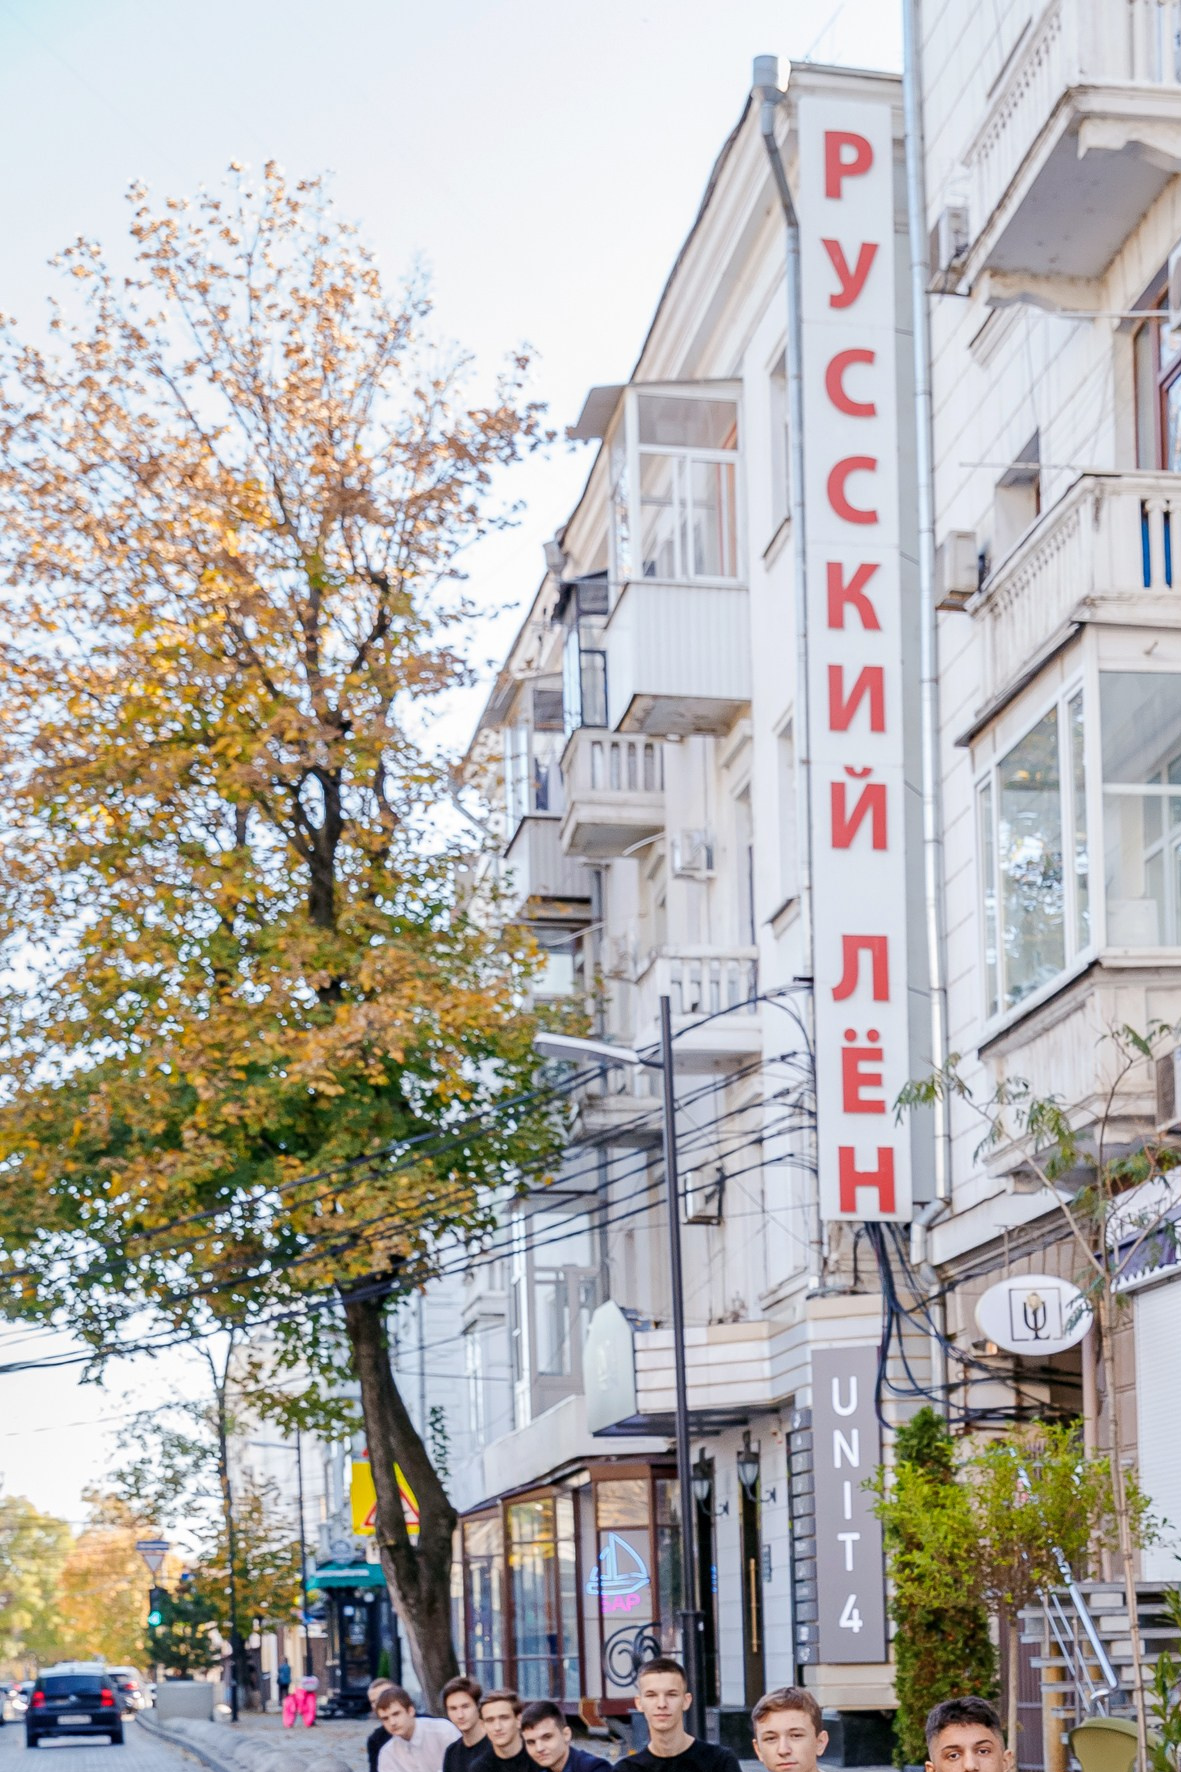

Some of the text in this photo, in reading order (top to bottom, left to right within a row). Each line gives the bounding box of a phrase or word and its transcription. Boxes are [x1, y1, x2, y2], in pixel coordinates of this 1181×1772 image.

[821, 129, 896, 1214] РУССКИЙ ЛЁН
[831, 1375, 864, 1634] UNIT 4
